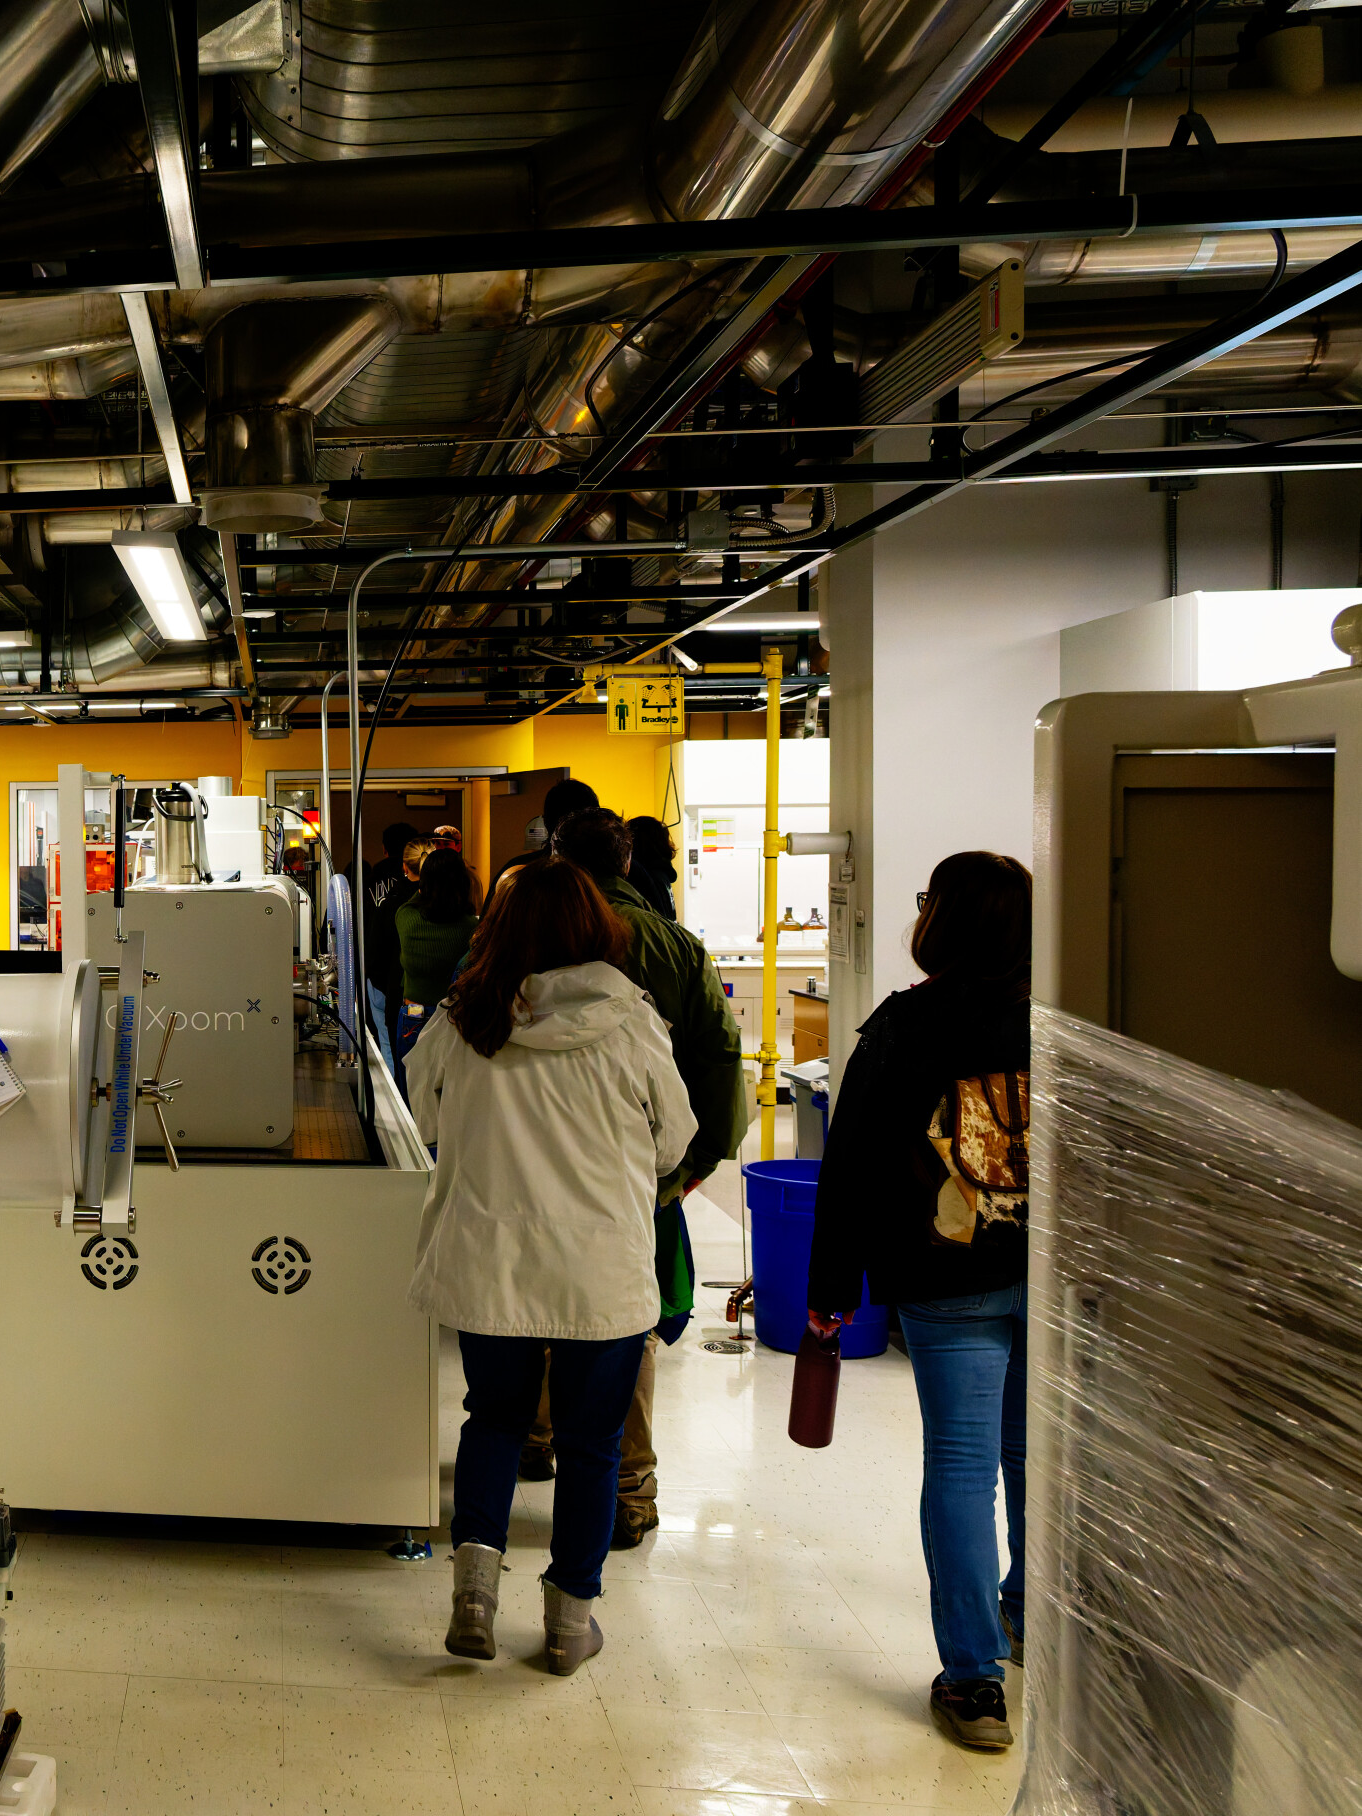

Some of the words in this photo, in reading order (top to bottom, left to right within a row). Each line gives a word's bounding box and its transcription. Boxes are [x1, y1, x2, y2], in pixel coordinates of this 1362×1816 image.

[641, 716, 671, 724] Bradley
[118, 996, 135, 1033] Vacuum
[117, 1035, 133, 1062] Under
[115, 1063, 131, 1091] While
[112, 1094, 131, 1118] Open
[111, 1119, 126, 1137] Not
[110, 1138, 125, 1153] Do
